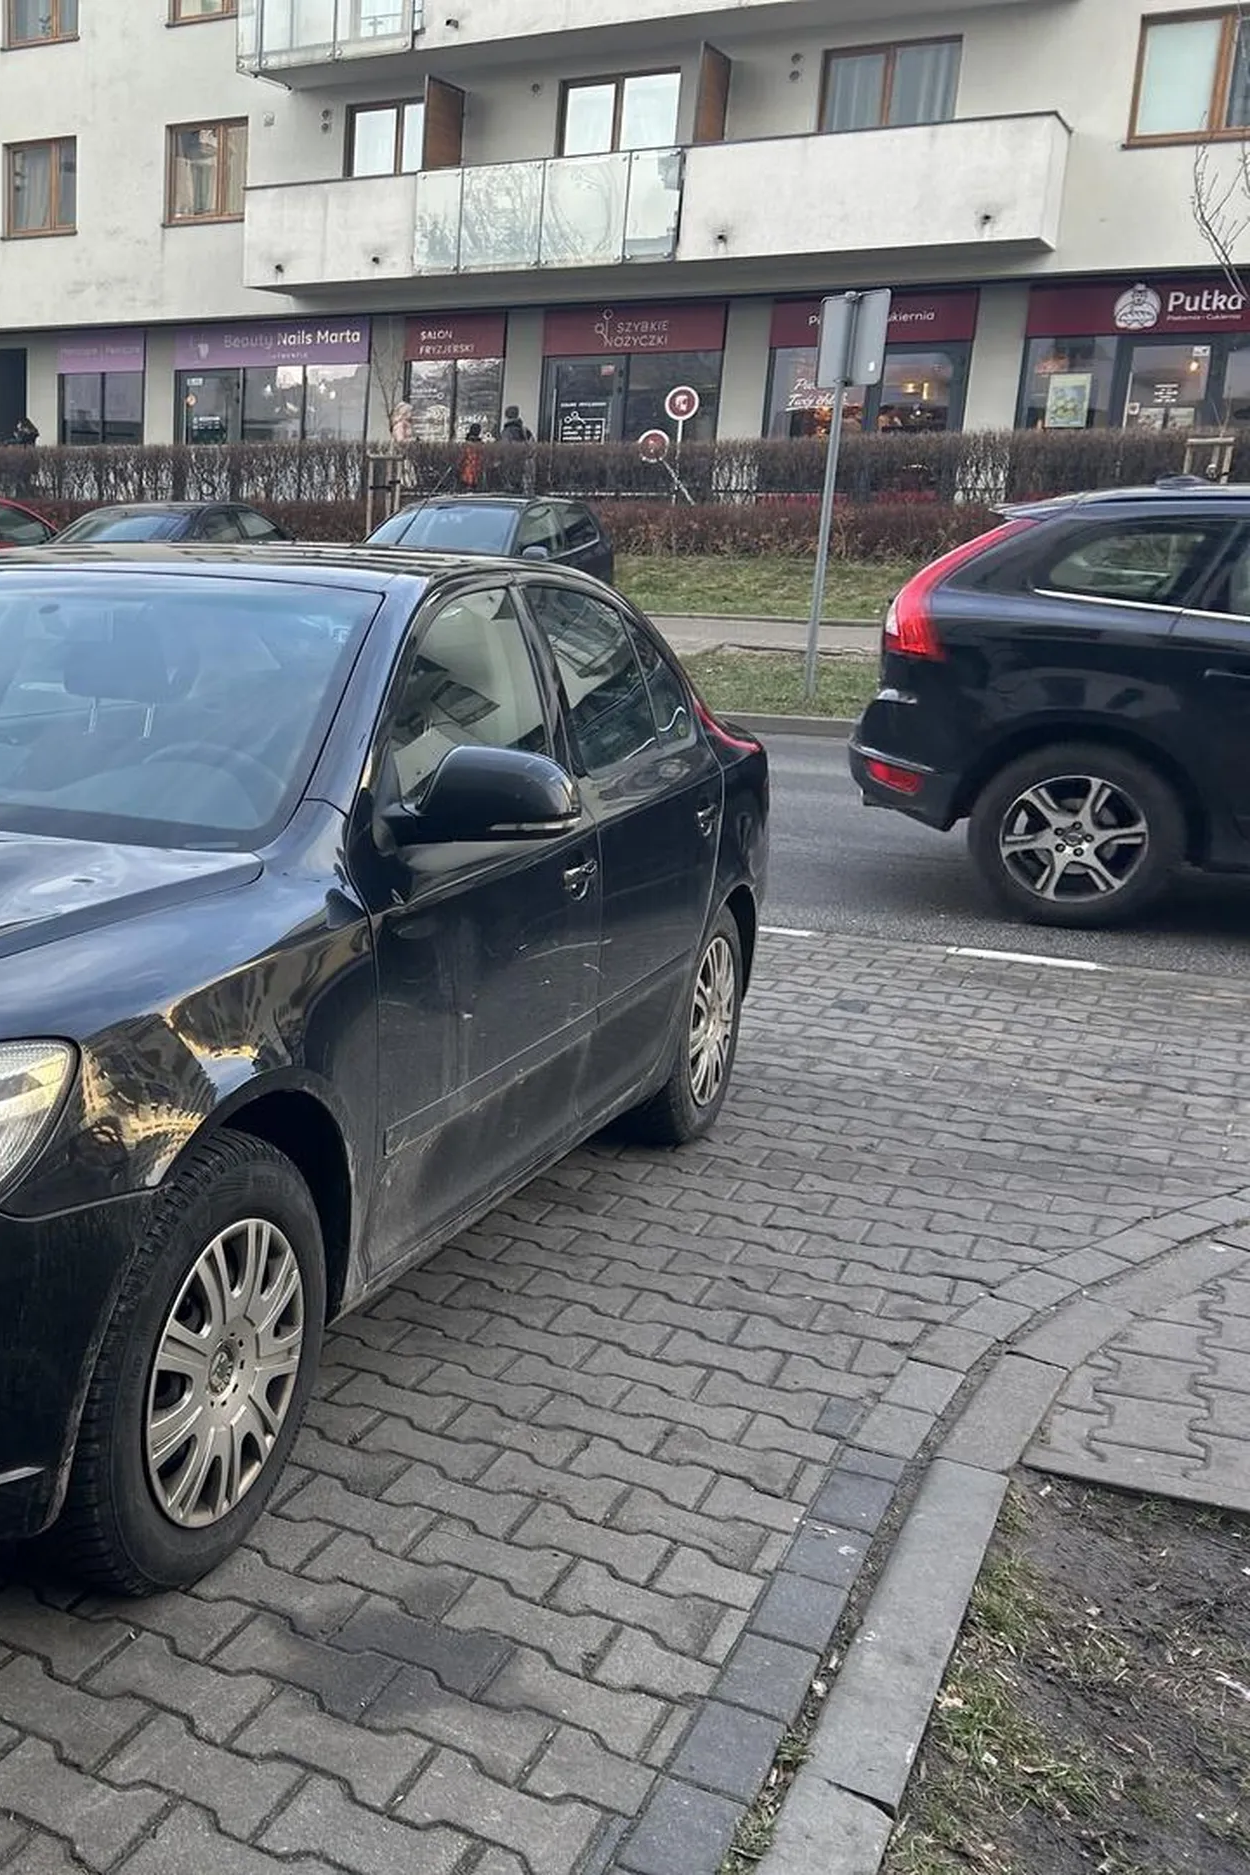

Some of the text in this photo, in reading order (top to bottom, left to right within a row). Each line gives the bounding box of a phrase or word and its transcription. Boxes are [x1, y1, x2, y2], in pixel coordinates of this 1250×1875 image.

[1167, 289, 1243, 312] Putka
[886, 311, 935, 323] ukiernia
[617, 320, 668, 333] SZYBKIE
[224, 329, 361, 349] Beauty Nails Marta
[420, 330, 453, 340] SALON
[419, 344, 475, 354] FRYZJERSKI
